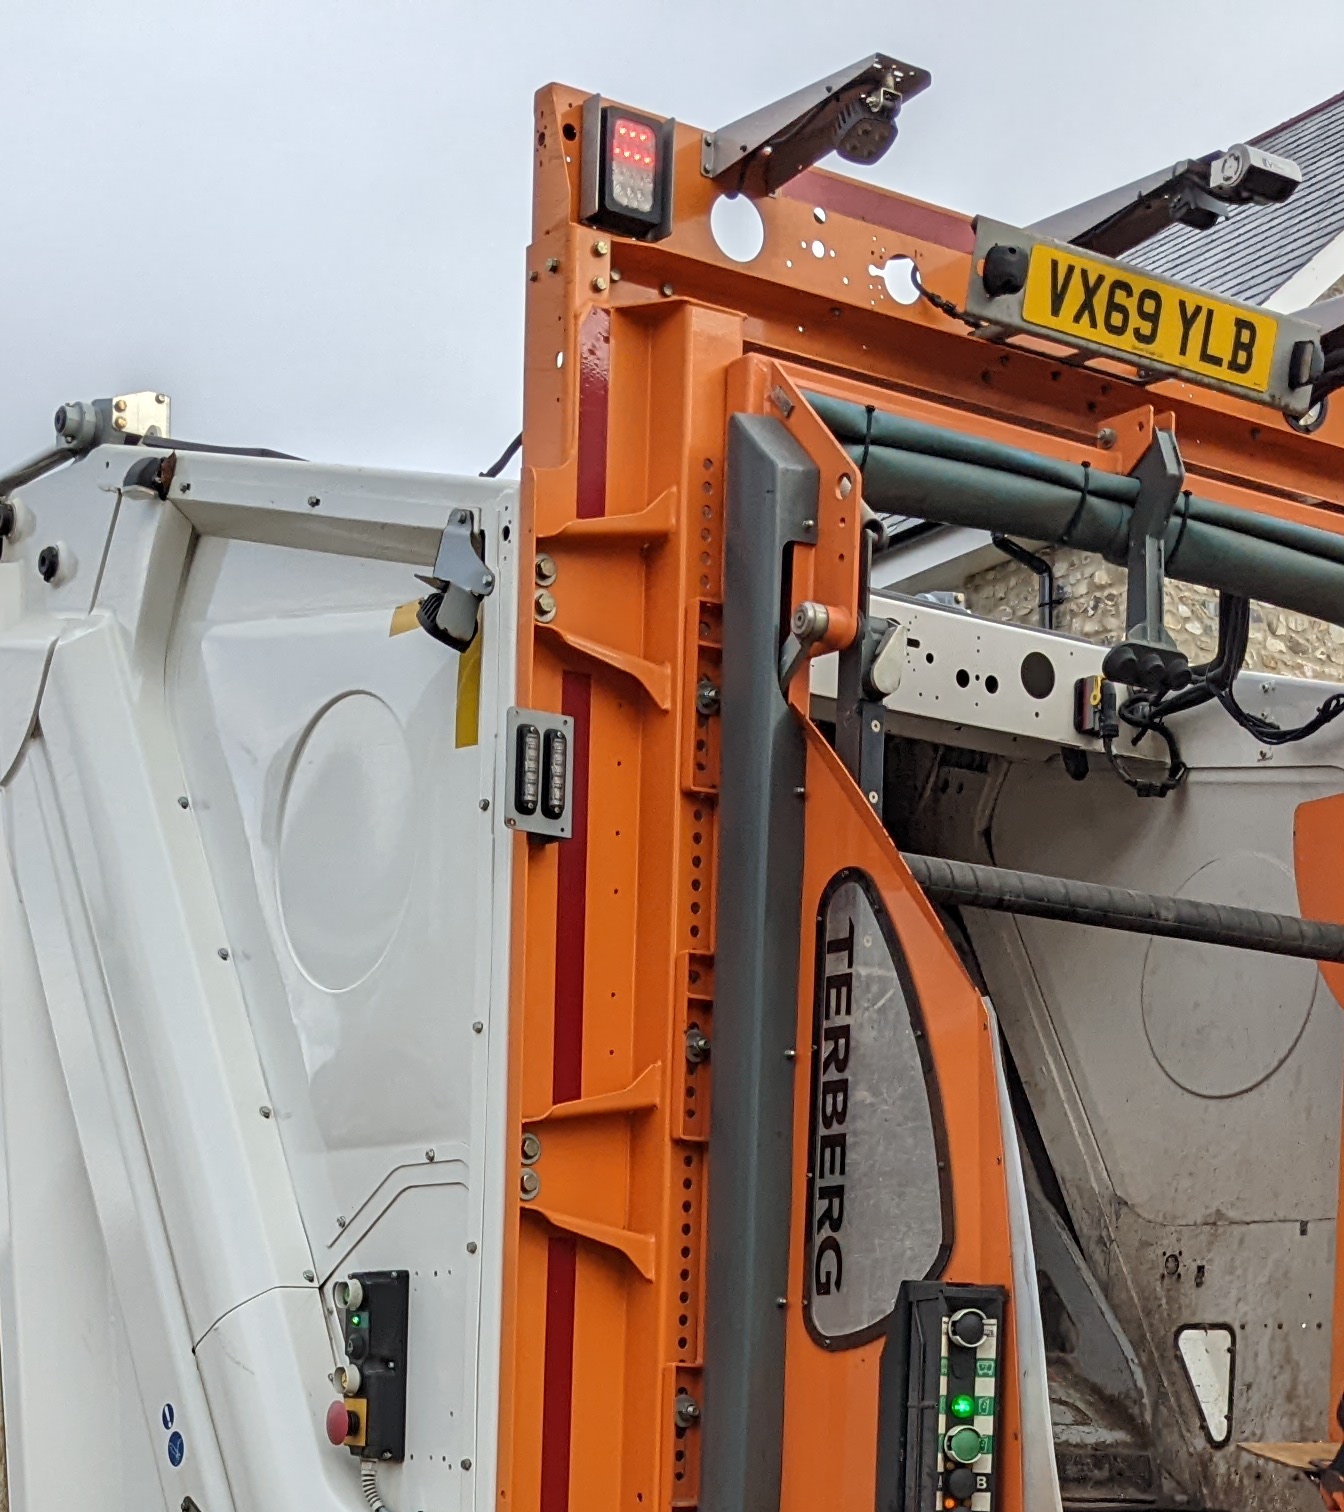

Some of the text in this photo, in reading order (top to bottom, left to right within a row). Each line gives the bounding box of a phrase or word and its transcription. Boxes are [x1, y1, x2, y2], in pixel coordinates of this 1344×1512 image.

[1050, 258, 1257, 375] VX69 YLB
[816, 916, 855, 1297] TERBERG
[976, 1475, 987, 1490] B
